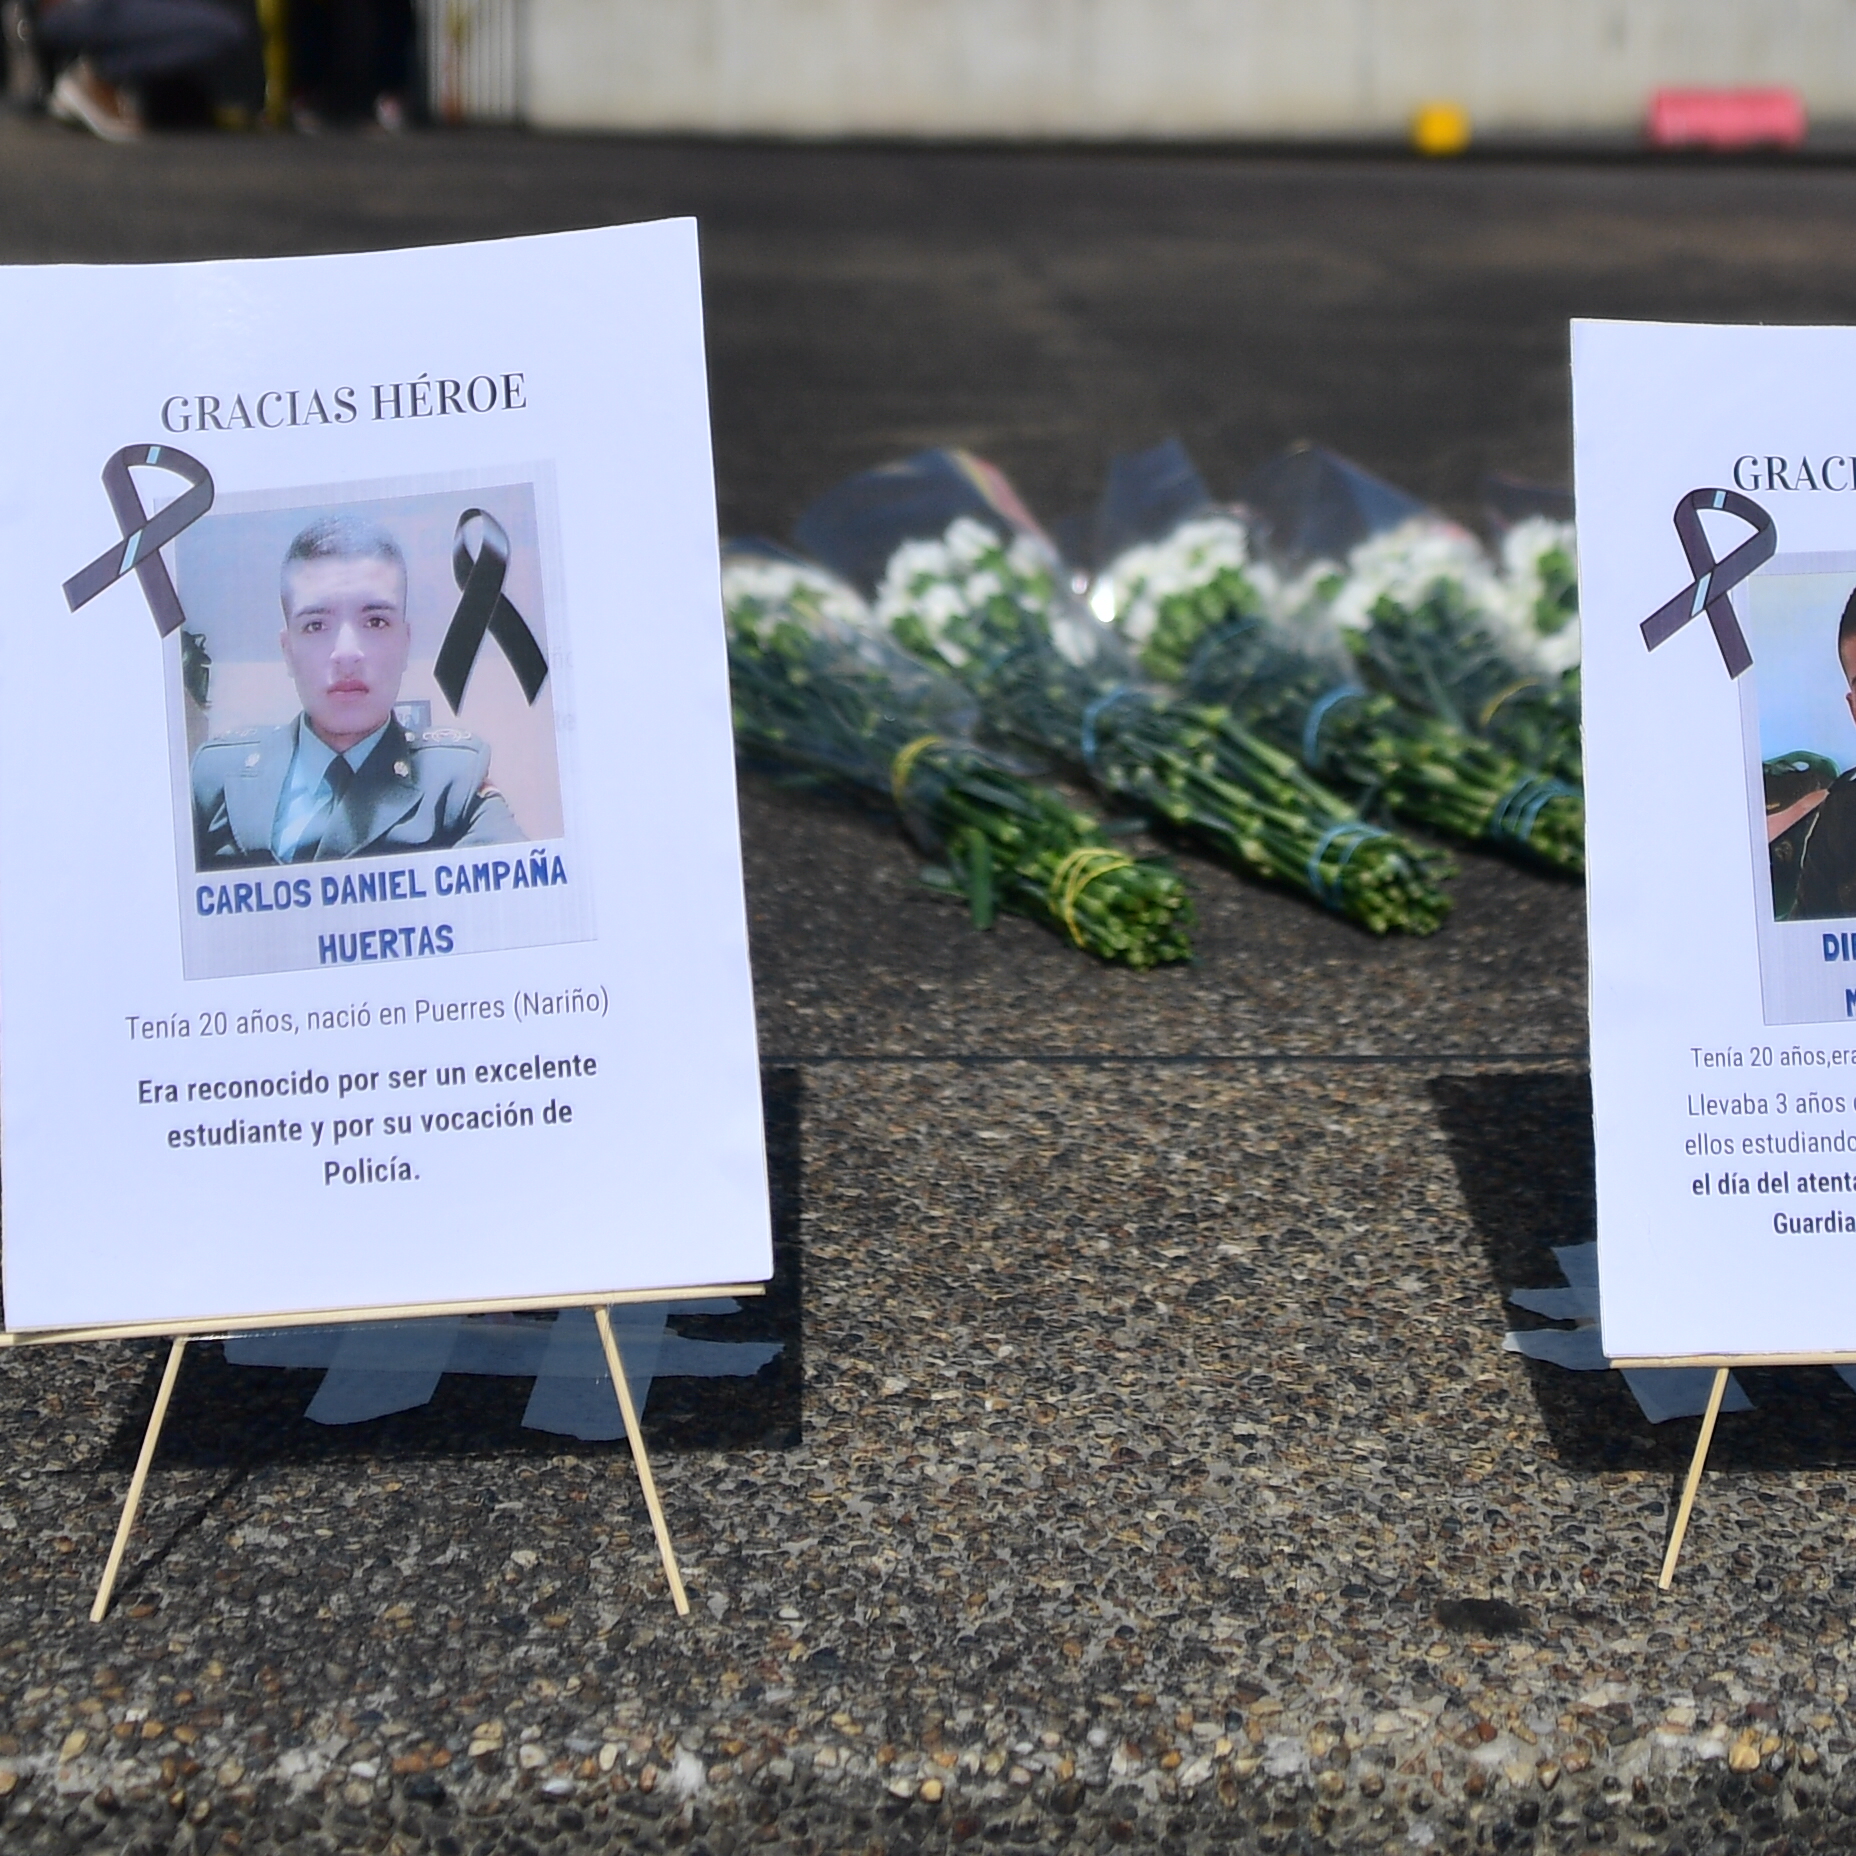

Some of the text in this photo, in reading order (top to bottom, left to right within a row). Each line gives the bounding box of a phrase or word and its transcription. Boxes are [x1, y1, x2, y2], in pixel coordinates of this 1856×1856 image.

[161, 373, 526, 433] GRACIAS HÉROE
[196, 848, 568, 916] CARLOS DANIEL CAMPAÑA
[318, 924, 454, 964] HUERTAS
[125, 985, 608, 1040] Tenía 20 años, nació en Puerres (Nariño)
[1690, 1046, 1743, 1068] Tenía
[1750, 1046, 1773, 1067] 20
[139, 1054, 597, 1104] Era reconocido por ser un excelente
[1688, 1092, 1768, 1116] Llevaba
[1776, 1093, 1787, 1114] 3
[1796, 1092, 1846, 1114] años
[168, 1098, 572, 1148] estudiante y por su vocación de
[1685, 1132, 1734, 1155] ellos
[324, 1155, 420, 1186] Policía.
[1692, 1172, 1710, 1195] el
[1718, 1172, 1750, 1195] día
[1757, 1171, 1789, 1194] del
[1773, 1210, 1856, 1234] Guardia
